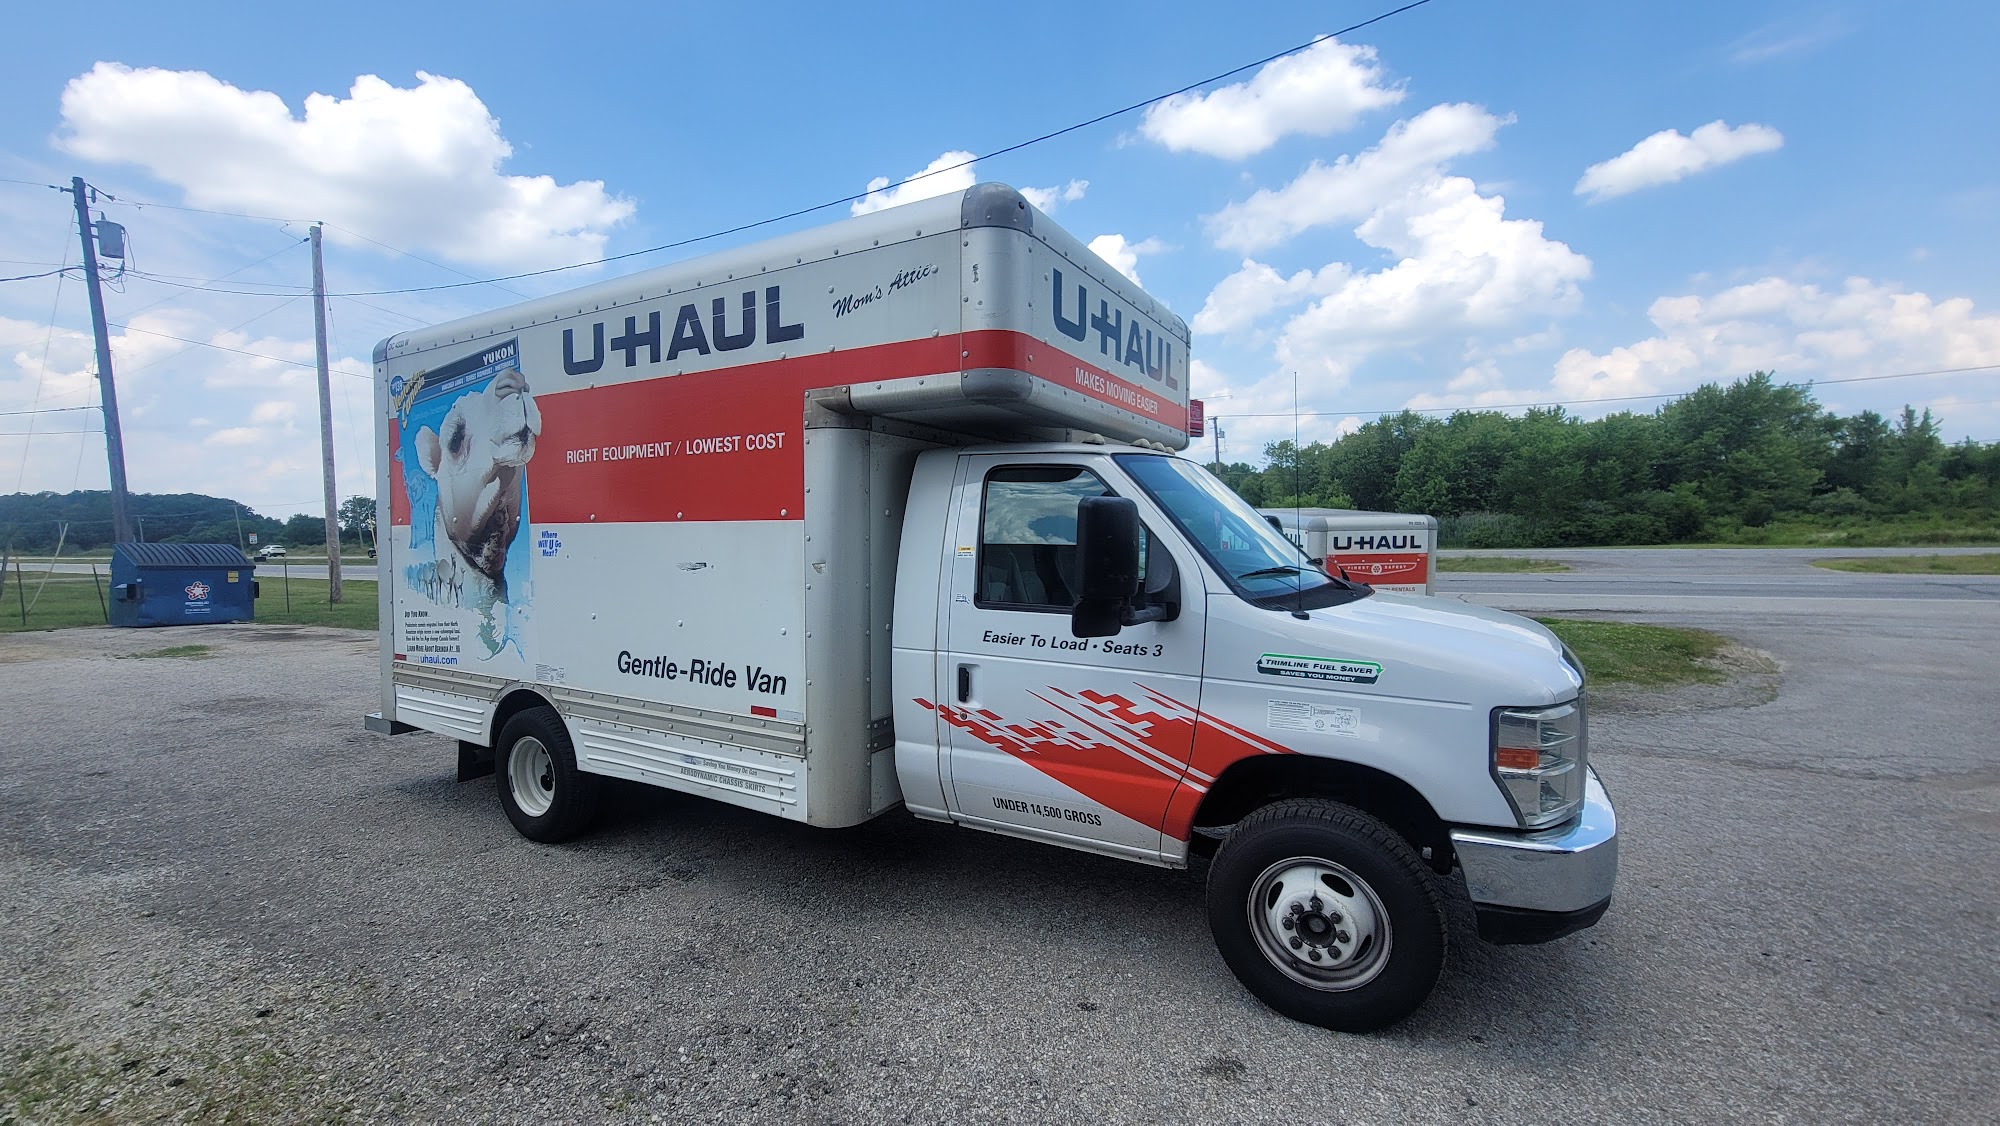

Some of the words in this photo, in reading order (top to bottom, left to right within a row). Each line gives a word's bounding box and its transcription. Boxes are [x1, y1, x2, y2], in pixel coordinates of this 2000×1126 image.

[832, 284, 884, 319] Mom's
[887, 263, 933, 296] Attic
[562, 285, 805, 376] U-HAUL
[1053, 268, 1178, 391] U-HAUL
[482, 344, 514, 366] YUKON
[1075, 366, 1105, 394] MAKES
[1106, 380, 1136, 406] MOVING
[1136, 393, 1158, 415] EASIER
[566, 447, 598, 464] RIGHT
[602, 441, 672, 461] EQUIPMENT
[686, 435, 741, 456] LOWEST
[745, 432, 786, 451] COST
[541, 530, 558, 539] Where
[548, 539, 554, 550] U
[1333, 535, 1422, 550] U-HAUL
[982, 630, 1026, 646] Easier
[1030, 634, 1046, 648] To
[1050, 636, 1089, 652] Load
[1102, 640, 1148, 656] Seats
[1152, 644, 1163, 657] 3
[420, 654, 458, 665] uhaul.com
[1265, 659, 1309, 669] TRIMLINE
[1313, 663, 1337, 672] FUEL
[617, 650, 737, 689] Gentle-Ride
[746, 665, 788, 696] Van
[1280, 670, 1306, 678] SAVES
[1307, 672, 1324, 680] YOU
[1325, 674, 1356, 682] MONEY
[702, 758, 718, 769] Saving
[717, 762, 726, 770] You
[680, 767, 718, 783] AERODYNAMIC
[719, 775, 744, 788] CHASSIS
[744, 782, 766, 793] SKIRTS
[992, 796, 1029, 814] UNDER
[1030, 803, 1062, 819] 14,500
[1064, 809, 1102, 826] GROSS
